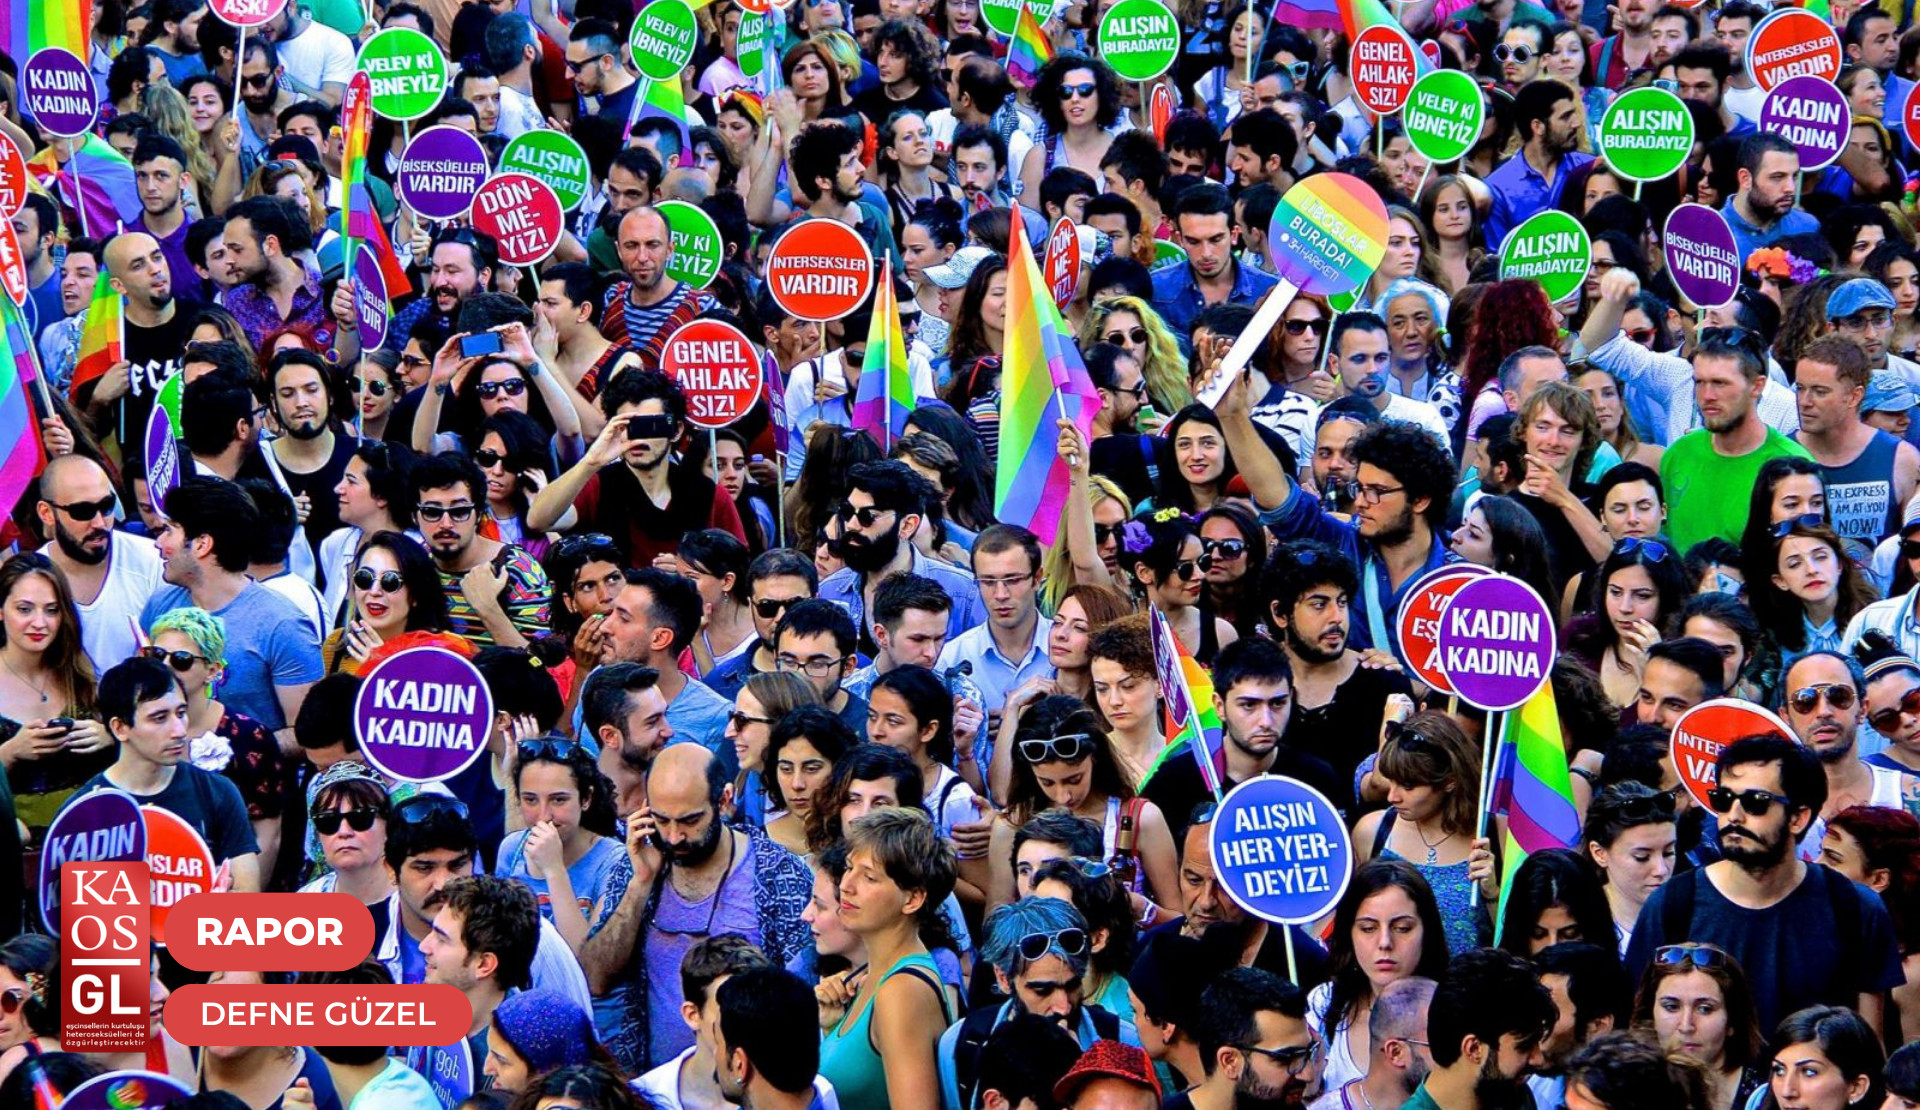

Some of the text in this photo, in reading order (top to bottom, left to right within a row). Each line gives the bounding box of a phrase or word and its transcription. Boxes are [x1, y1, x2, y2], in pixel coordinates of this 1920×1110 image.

[645, 14, 691, 44] VELEV Kİ
[742, 17, 764, 39] ALIŞI
[1108, 15, 1170, 38] ALIŞIN
[633, 27, 687, 66] İBNEYİZ
[1103, 38, 1175, 53] BURADAYIZ
[1360, 41, 1408, 62] GENEL
[1755, 36, 1835, 67] İNTERSEKSLER
[364, 50, 434, 72] VELEV Kİ
[29, 69, 87, 92] KADIN
[371, 71, 442, 97] BNEYİZ
[1359, 64, 1413, 85] AHLAK-
[31, 94, 93, 116] KADINA
[1369, 87, 1398, 106] SIZ!
[1417, 91, 1476, 120] VELEV Kİ
[1612, 109, 1684, 134] ALIŞIN
[1770, 95, 1841, 125] KADIN
[1408, 106, 1473, 145] İBNEYİZ
[1604, 134, 1689, 150] BURADAYIZ
[402, 159, 485, 174] BİSEKSÜELLER
[512, 144, 583, 176] ALIŞIN
[409, 175, 475, 194] VARDIR
[479, 179, 539, 214] DÖN-
[495, 205, 540, 235] ME-
[1300, 195, 1369, 255] LİBOŞLAR
[500, 226, 550, 259] YİZ!
[694, 235, 711, 252] Kİ
[1052, 225, 1075, 258] DÖN-
[1289, 215, 1352, 269] BURADA!
[1512, 232, 1580, 259] ALIŞIN
[1666, 232, 1737, 267] BİSEKSÜELLER
[773, 254, 866, 271] İNTERSEKSLER
[1504, 258, 1585, 277] BURADAYIZ
[1673, 249, 1732, 286] VARDIR
[779, 274, 859, 296] VARDIR
[673, 340, 747, 364] GENEL
[676, 367, 756, 390] AHLAK-
[691, 394, 737, 417] SIZ!
[1845, 485, 1886, 499] EXPRESS
[1835, 503, 1850, 514] AM
[1852, 501, 1865, 513] AT
[1838, 517, 1878, 535] NOW!
[1451, 607, 1540, 643] KADIN
[1447, 646, 1541, 679] KADINA
[374, 678, 477, 715] KADIN
[366, 717, 474, 751] KADINA
[1235, 801, 1317, 832] ALIŞIN
[51, 822, 137, 870] KADIN
[1221, 833, 1338, 868] HER YER-
[1244, 863, 1331, 898] DEYİZ!
